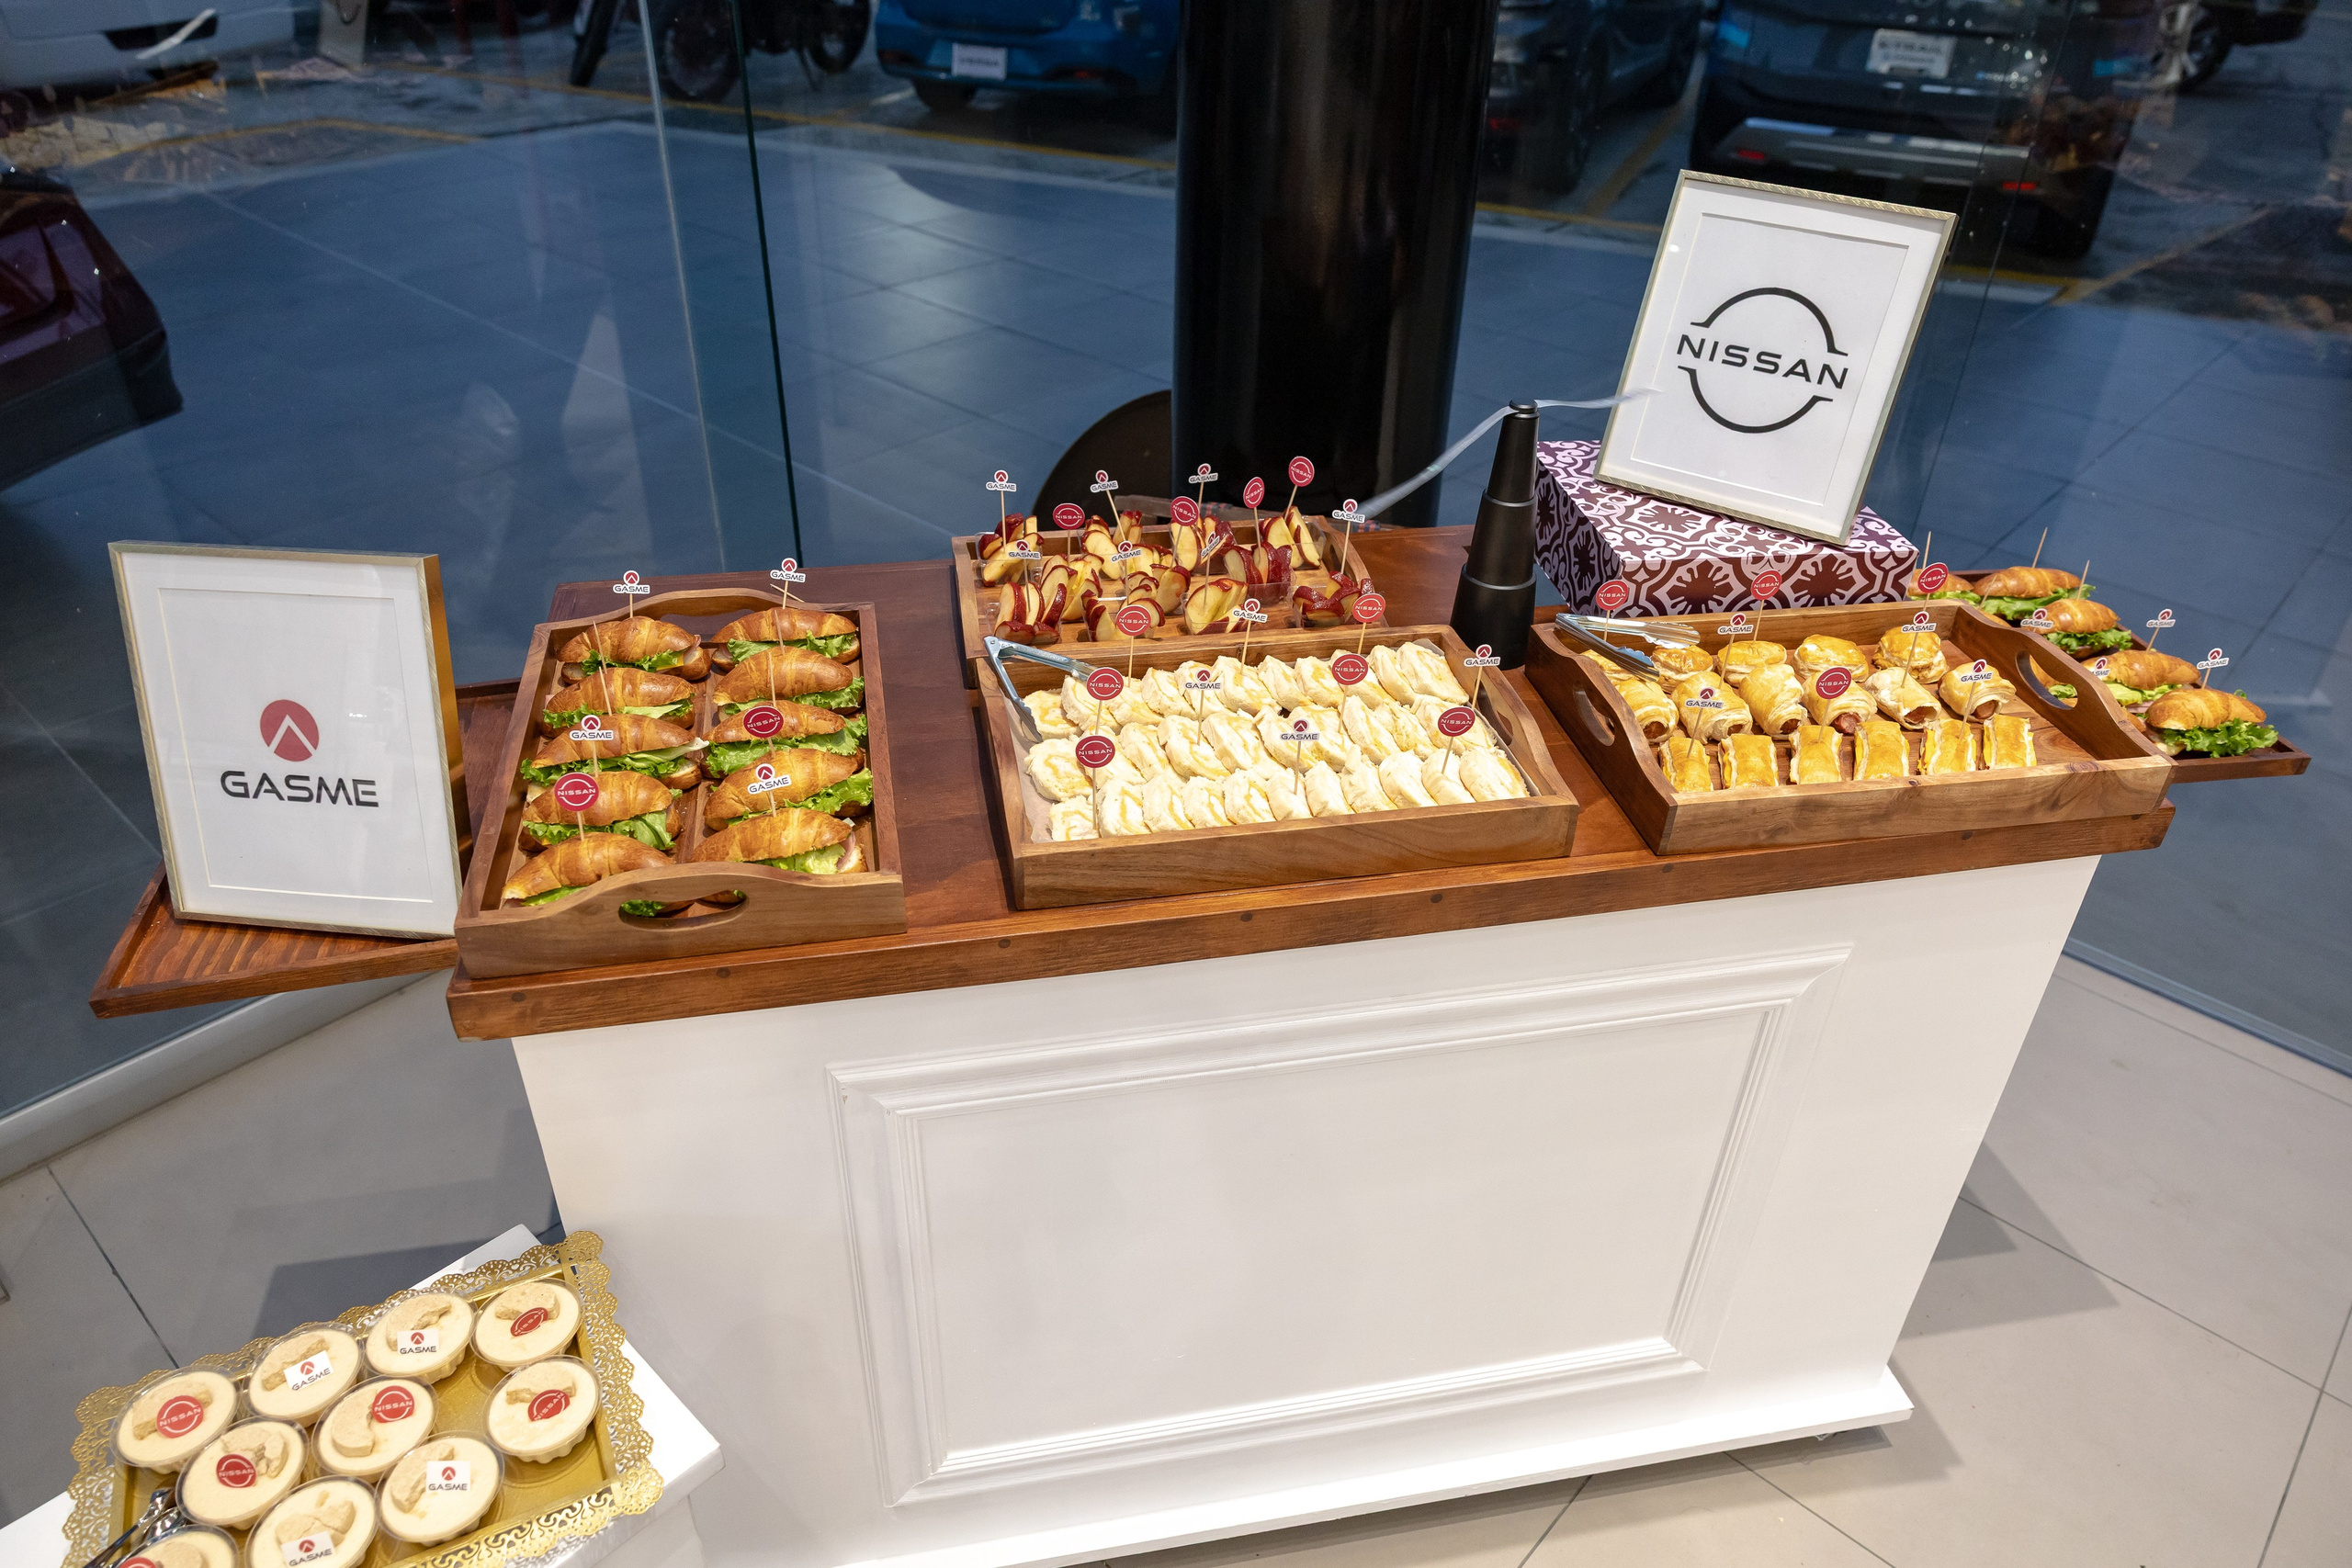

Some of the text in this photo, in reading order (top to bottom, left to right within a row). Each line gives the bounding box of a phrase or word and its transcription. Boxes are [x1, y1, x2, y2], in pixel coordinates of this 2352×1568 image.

[1677, 334, 1849, 389] NISSAN
[1190, 474, 1216, 482] GASME
[1291, 467, 1311, 479] NISSAN
[1091, 482, 1117, 491] GASME
[1246, 489, 1263, 499] NISSAN
[1174, 506, 1196, 519] NISSAN
[1334, 512, 1363, 522] GASME
[1113, 550, 1140, 561] GASME
[771, 571, 804, 581] GASME
[1921, 574, 1946, 582] NISSAN
[615, 585, 649, 593] GASME
[1233, 611, 1266, 621] GASME
[2199, 659, 2227, 668] GASME
[1962, 672, 1992, 681] GASME
[1686, 700, 1722, 708] GASME
[747, 716, 780, 728] NISSAN
[220, 771, 379, 807] GASME
[750, 778, 789, 793] GASME
[514, 1309, 545, 1335] NISSAN
[292, 1368, 330, 1390] GASME
[375, 1401, 412, 1412] NISSAN
[535, 1392, 565, 1419] NISSAN
[160, 1407, 200, 1426] NISSAN
[429, 1483, 467, 1491] GASME
[289, 1549, 332, 1565] GASME
